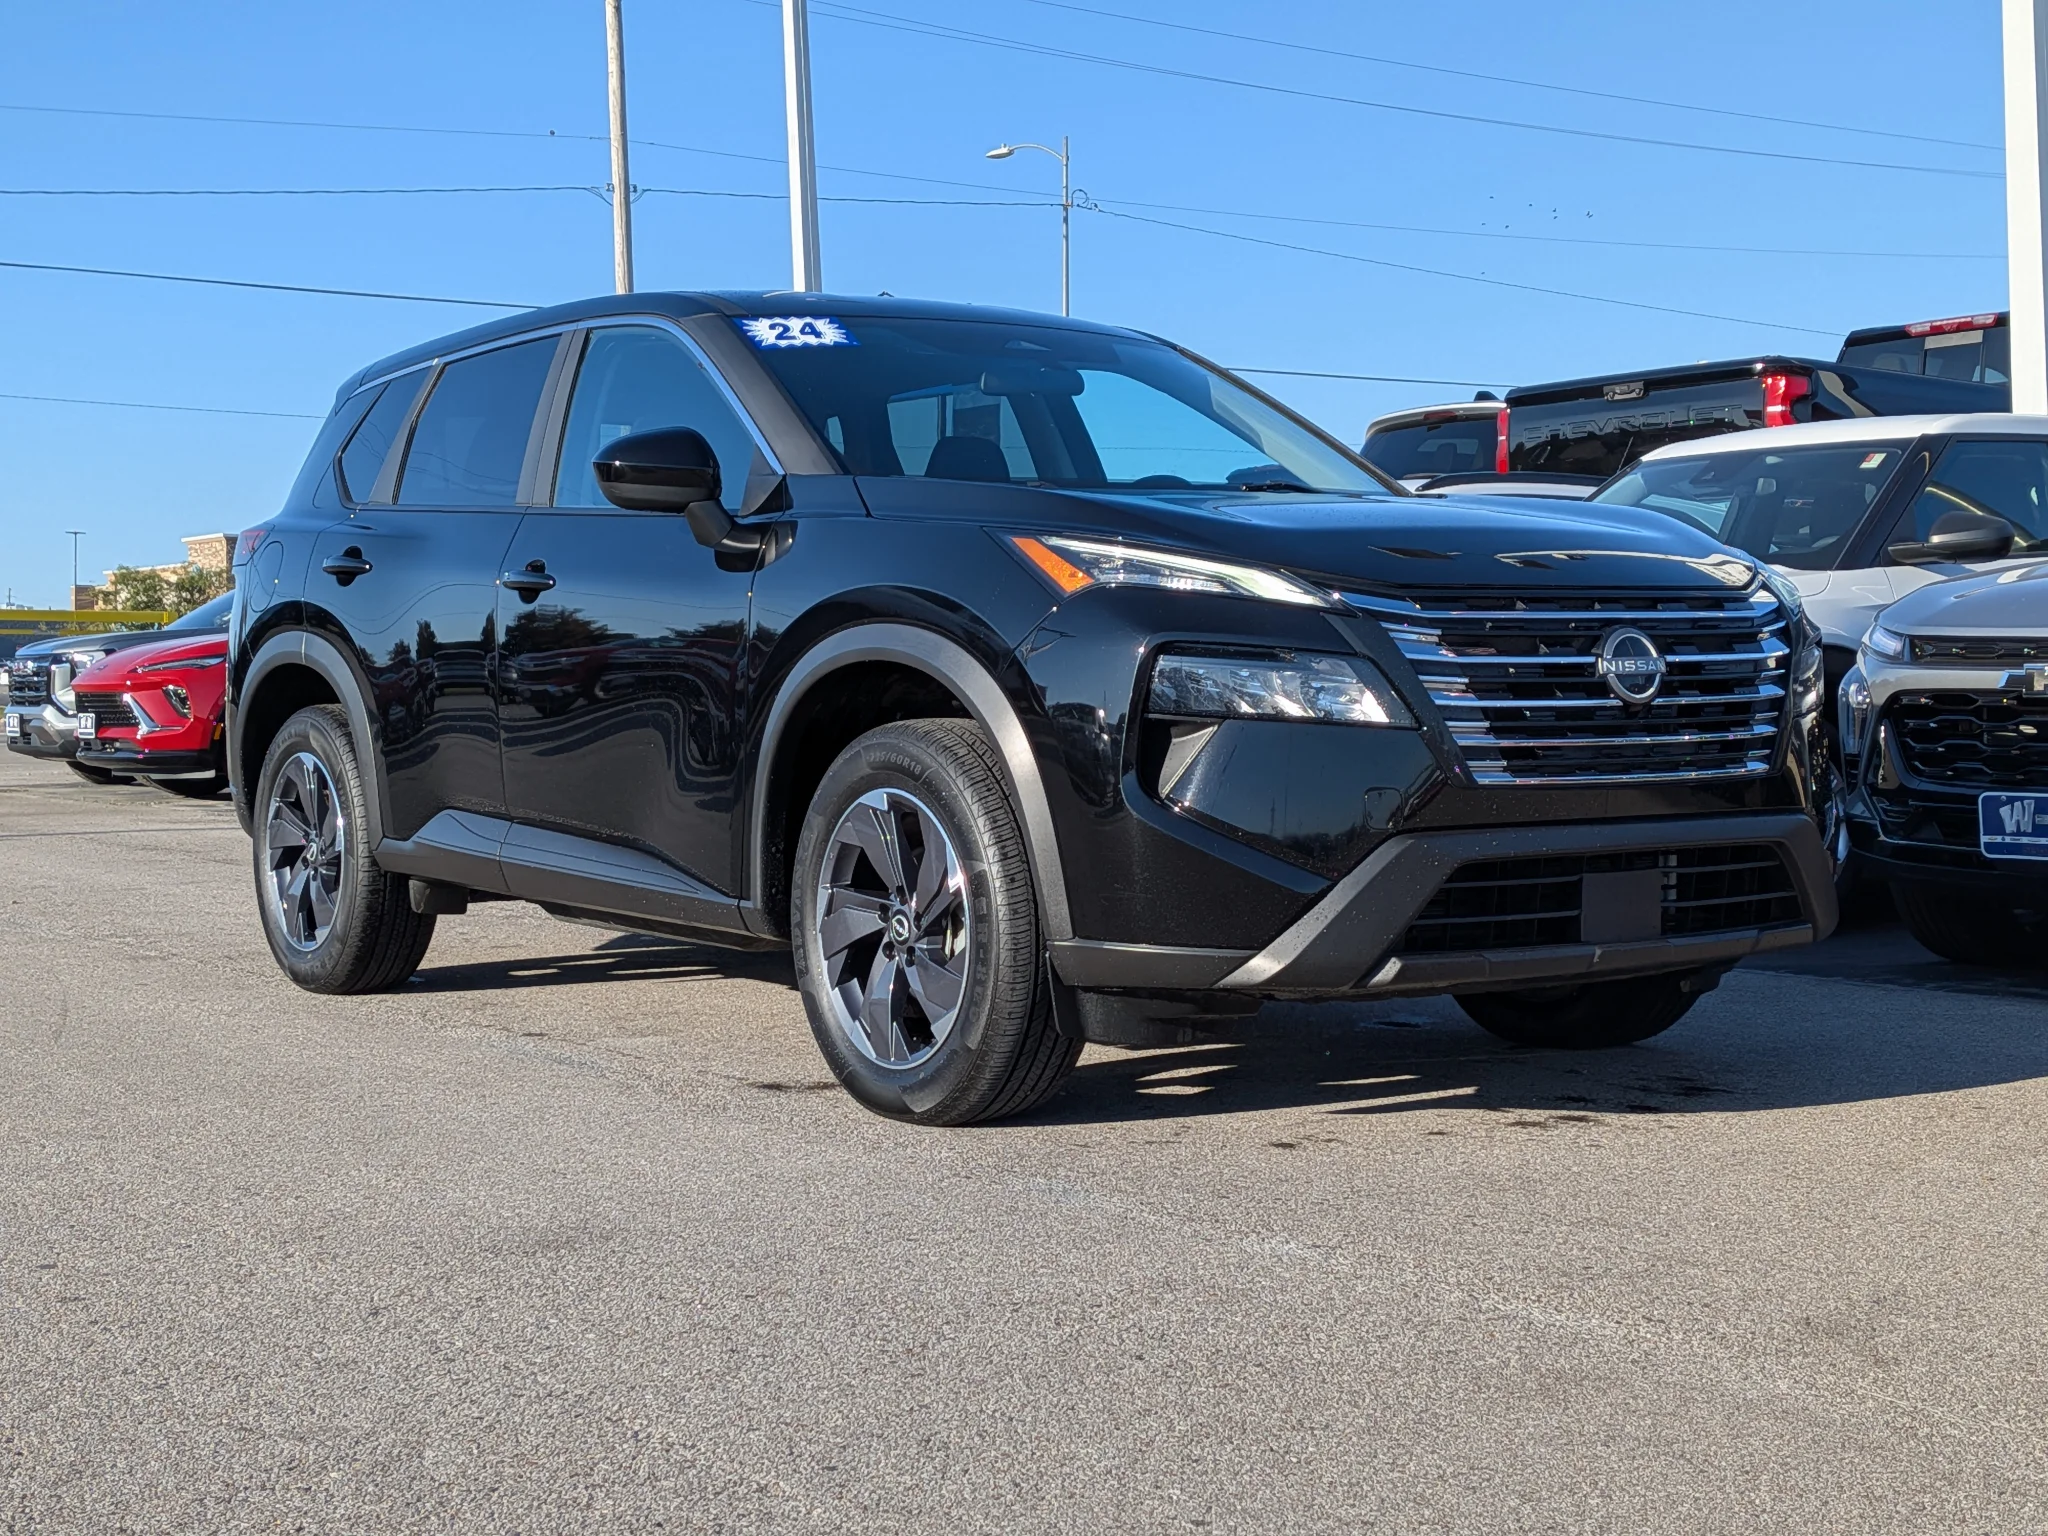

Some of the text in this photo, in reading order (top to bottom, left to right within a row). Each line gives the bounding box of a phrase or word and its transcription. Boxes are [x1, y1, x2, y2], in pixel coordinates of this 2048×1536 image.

[768, 322, 822, 340] 24
[1522, 404, 1743, 443] CHEVROLET
[1603, 660, 1664, 672] NISSAN
